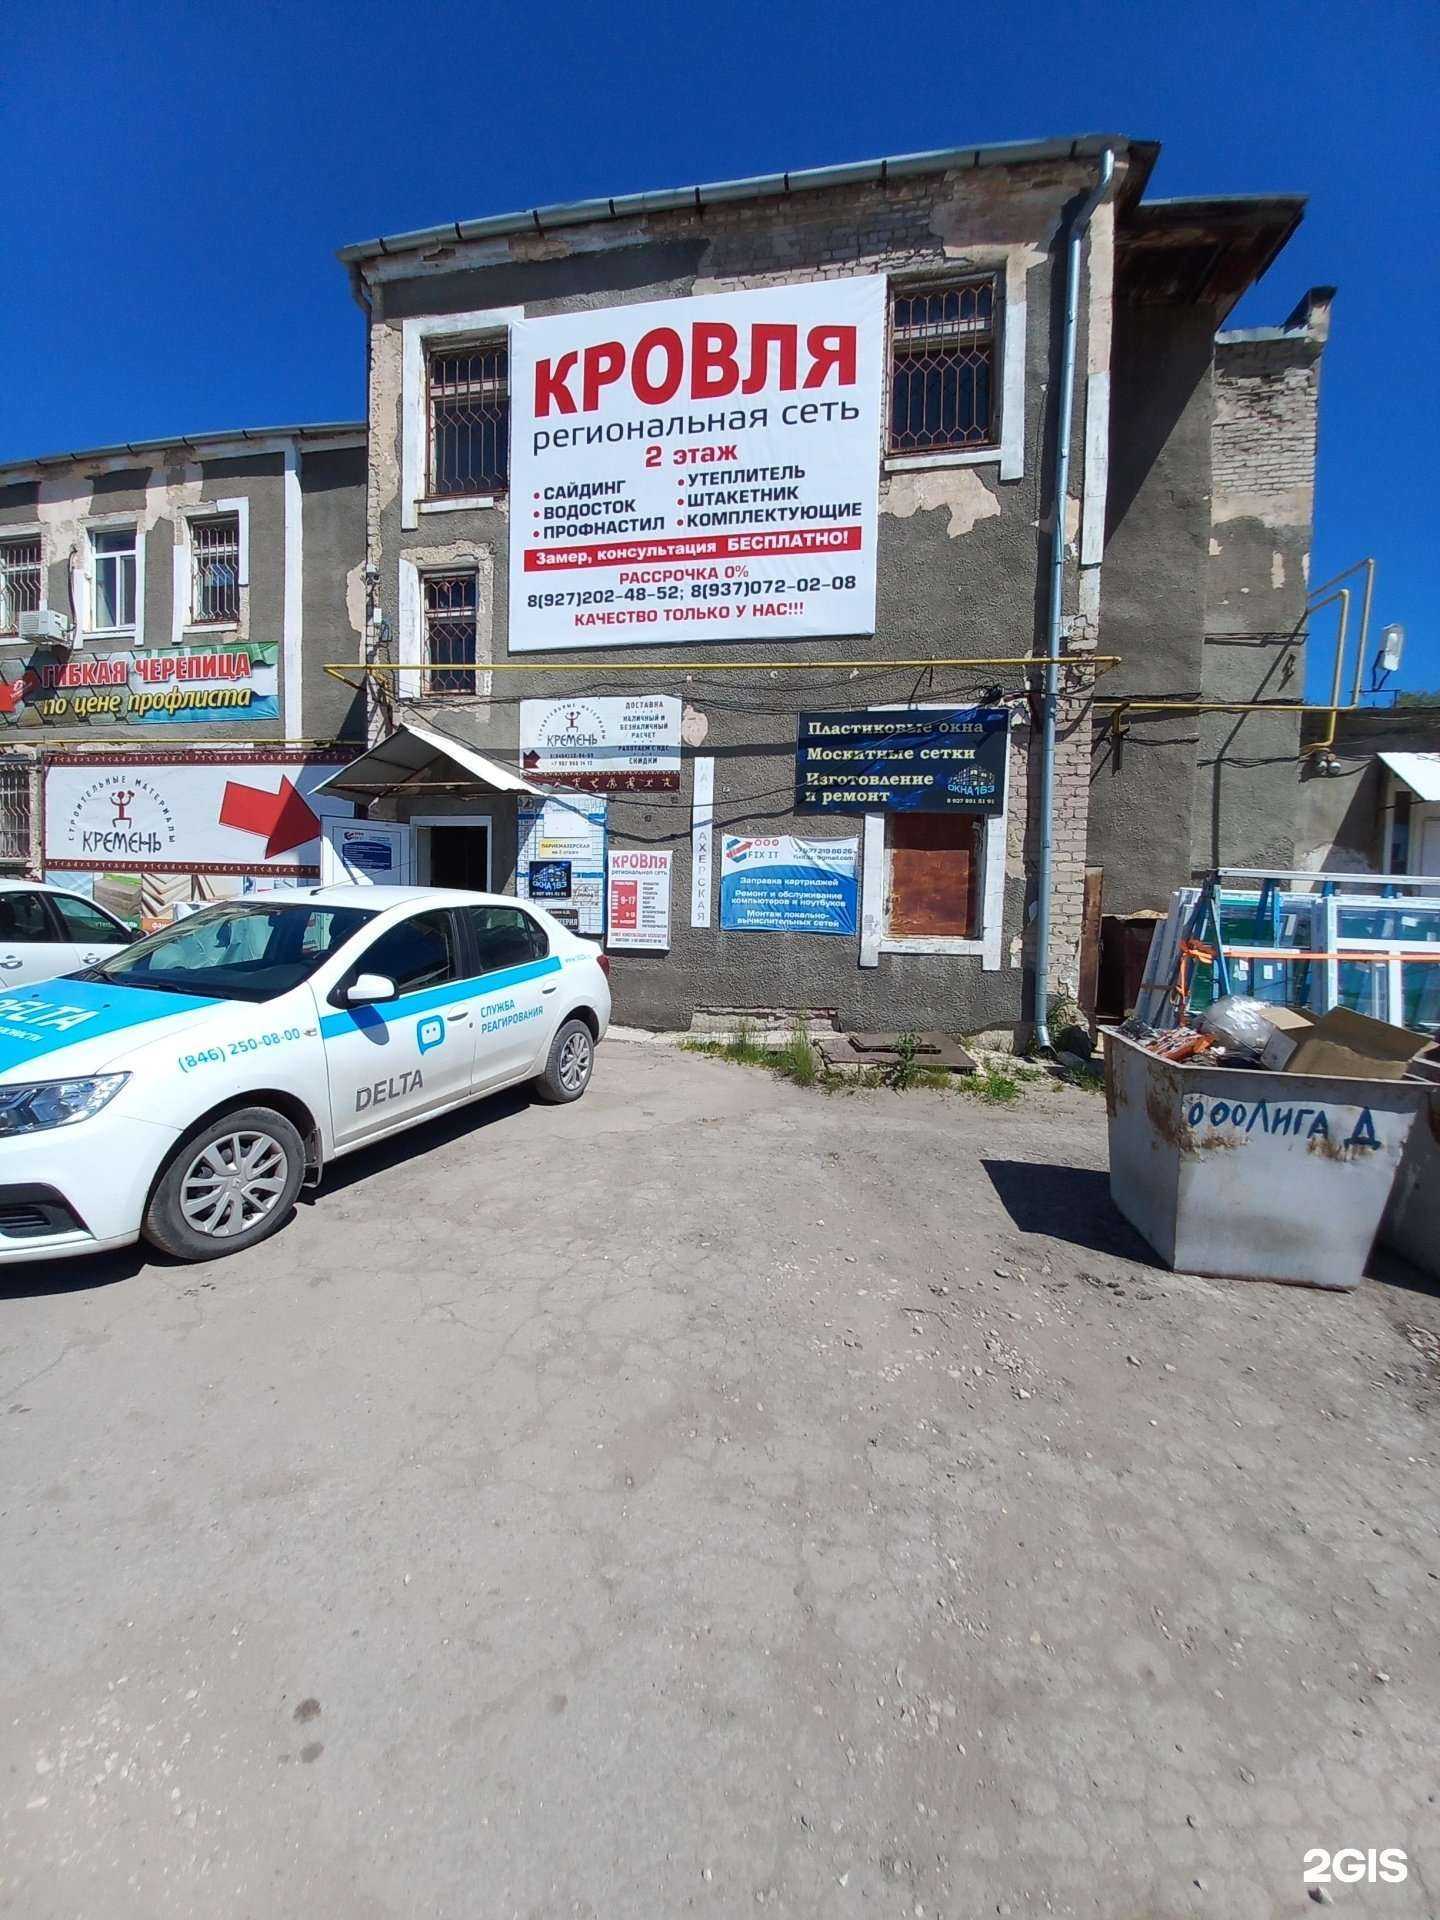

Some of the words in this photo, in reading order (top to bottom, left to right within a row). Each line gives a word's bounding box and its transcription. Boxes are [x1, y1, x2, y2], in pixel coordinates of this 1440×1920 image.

[534, 321, 857, 417] КРОВЛЯ
[533, 407, 768, 455] региональная
[782, 399, 860, 425] сеть
[645, 446, 662, 468] 2
[673, 443, 738, 466] этаж
[688, 465, 805, 488] УТЕПЛИТЕЛЬ
[544, 479, 626, 500] САЙДИНГ
[687, 486, 799, 508] ШТАКЕТНИК
[543, 499, 636, 520] ВОДОСТОК
[687, 502, 862, 528] КОМПЛЕКТУЮЩИЕ
[543, 517, 665, 540] ПРОФНАСТИЛ
[536, 549, 593, 566] Замер,
[597, 540, 717, 562] консультация
[727, 531, 849, 552] БЕСПЛАТНО!
[619, 566, 718, 586] РАССРОЧКА
[725, 564, 749, 580] 0%
[527, 586, 684, 609] 8(927)202-48-52;
[691, 575, 857, 600] 8(937)072-02-08
[574, 609, 658, 627] КАЧЕСТВО
[664, 604, 730, 622] ТОЛЬКО
[736, 605, 746, 619] У
[752, 601, 804, 617] НАС!!!
[42, 660, 128, 688] ГИБКАЯ
[135, 652, 251, 683] ЧЕРЕПИЦА
[43, 697, 67, 715] по
[74, 693, 120, 716] цене
[127, 686, 251, 716] профлиста
[626, 701, 664, 710] ДОСТАВКА
[620, 722, 668, 731] БЕЗНАЛИЧНЫЙ
[623, 714, 659, 722] НАЛИЧНЫЙ
[808, 722, 932, 735] Пластиковые
[938, 721, 984, 733] окна
[547, 733, 598, 747] КРЕМЕНЬ
[629, 757, 658, 765] СКИДКИ
[807, 748, 914, 760] Москитные
[920, 749, 975, 760] сетки
[806, 772, 934, 786] Изготовление
[68, 776, 126, 841] СТРОИТЕЛЬНЫЕ
[135, 778, 176, 842] МАТЕРИАЛЫ
[805, 792, 816, 801] и
[822, 791, 890, 805] ремонт
[82, 831, 162, 853] КРЕМЕНЬ
[612, 854, 667, 868] КРОВЛЯ
[740, 877, 782, 886] Заправка
[785, 878, 838, 886] картриджей
[731, 898, 790, 906] компьютеров
[800, 899, 846, 907] ноутбуков
[735, 890, 767, 898] Ремонт
[778, 890, 842, 899] обслуживание
[737, 918, 811, 926] вычислительных
[747, 910, 781, 918] Монтаж
[480, 999, 516, 1018] СЛУЖБА
[480, 1006, 544, 1034] РЕАГИРОВАНИЯ
[178, 1046, 226, 1073] (846)
[227, 1027, 300, 1055] 250-08-00
[355, 1069, 424, 1112] DELTA
[1344, 1106, 1382, 1150] Д
